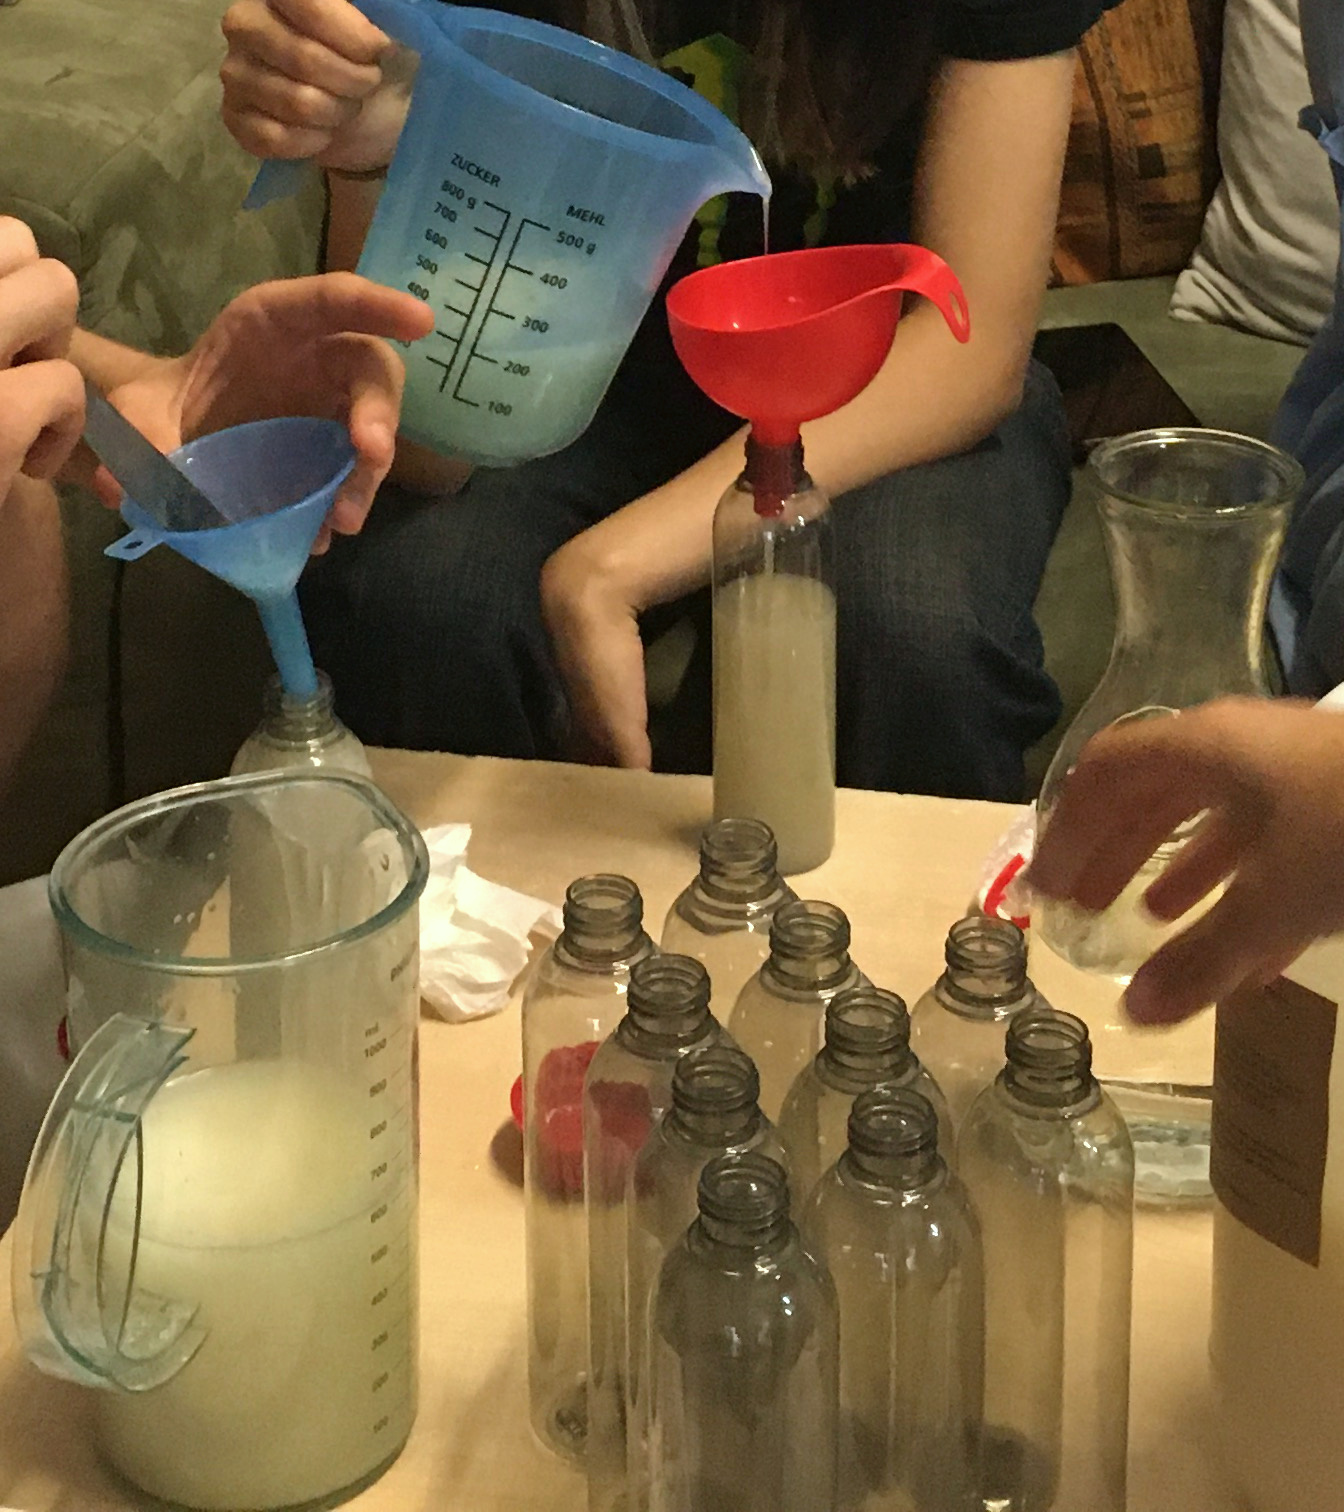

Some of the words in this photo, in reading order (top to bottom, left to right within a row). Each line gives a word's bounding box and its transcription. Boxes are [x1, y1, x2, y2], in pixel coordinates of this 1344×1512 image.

[450, 152, 501, 188] ZUCKER
[440, 179, 465, 201] 800
[466, 196, 478, 211] g
[433, 201, 458, 224] 700
[565, 205, 606, 227] MEHL
[424, 228, 448, 250] 600
[555, 230, 585, 249] 500
[586, 243, 597, 256] g
[415, 253, 439, 275] 500
[407, 280, 430, 301] 400
[539, 272, 569, 290] 400
[521, 314, 550, 334] 300
[503, 360, 531, 377] 200
[488, 400, 513, 417] 100
[364, 1037, 387, 1058] 1000
[370, 1161, 388, 1182] 700
